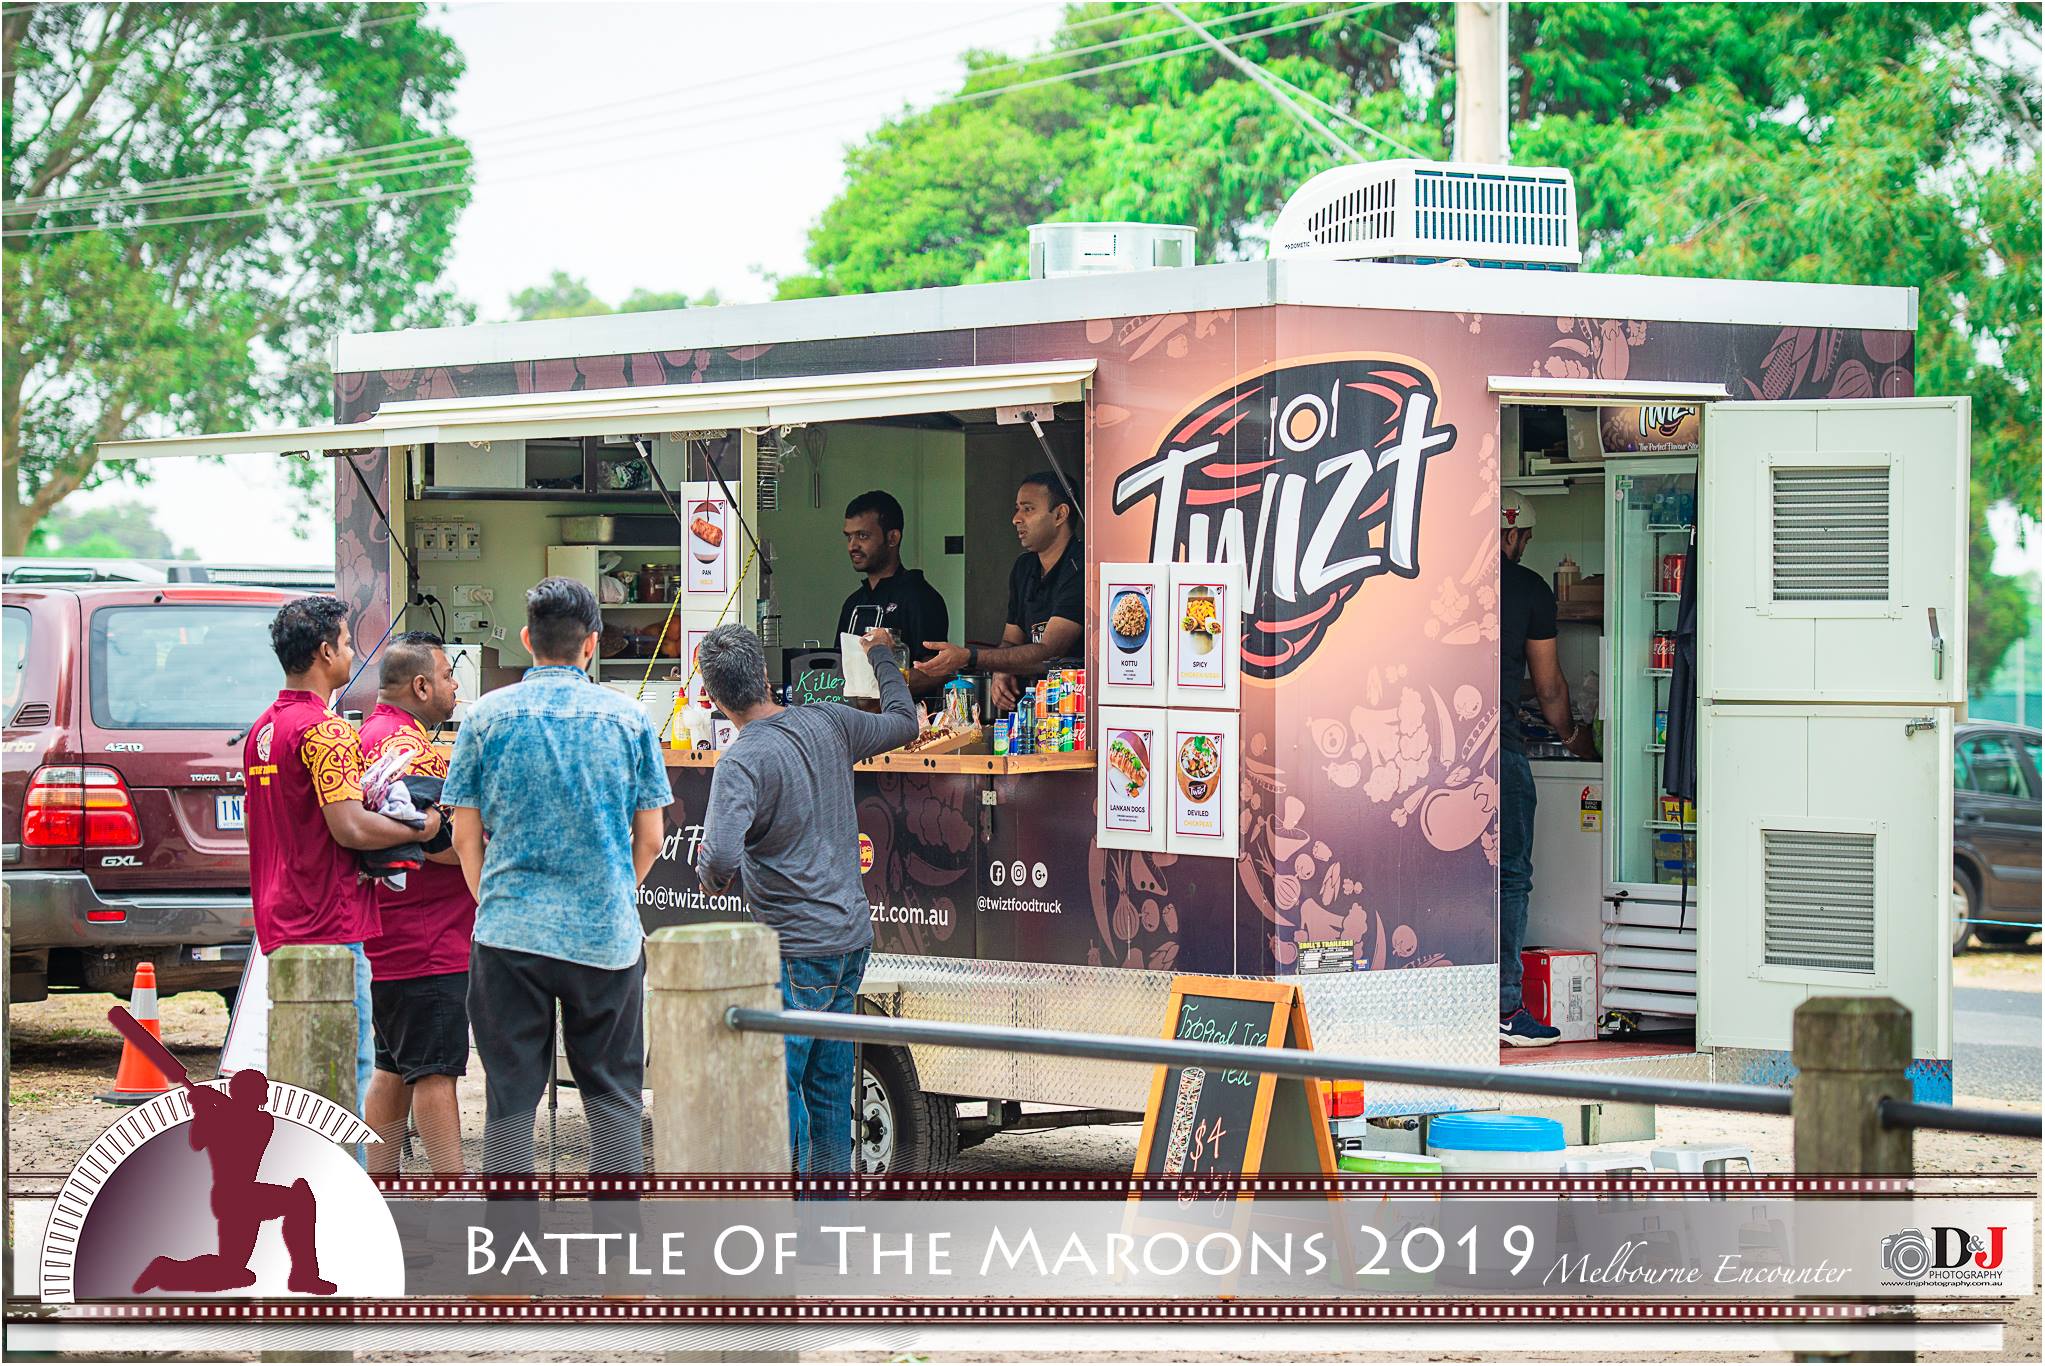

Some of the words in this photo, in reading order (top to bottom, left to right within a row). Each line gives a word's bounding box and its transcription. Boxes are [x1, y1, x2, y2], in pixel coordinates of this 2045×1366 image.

[1639, 407, 1696, 437] Twiz
[190, 773, 221, 782] TOYOTA
[1110, 804, 1131, 813] LANKAN
[1131, 805, 1146, 814] DOGS
[1187, 809, 1209, 817] DEVILED
[101, 856, 143, 868] GXL
[977, 895, 1062, 914] @twiztfoodtruck
[1189, 1116, 1227, 1173] $4
